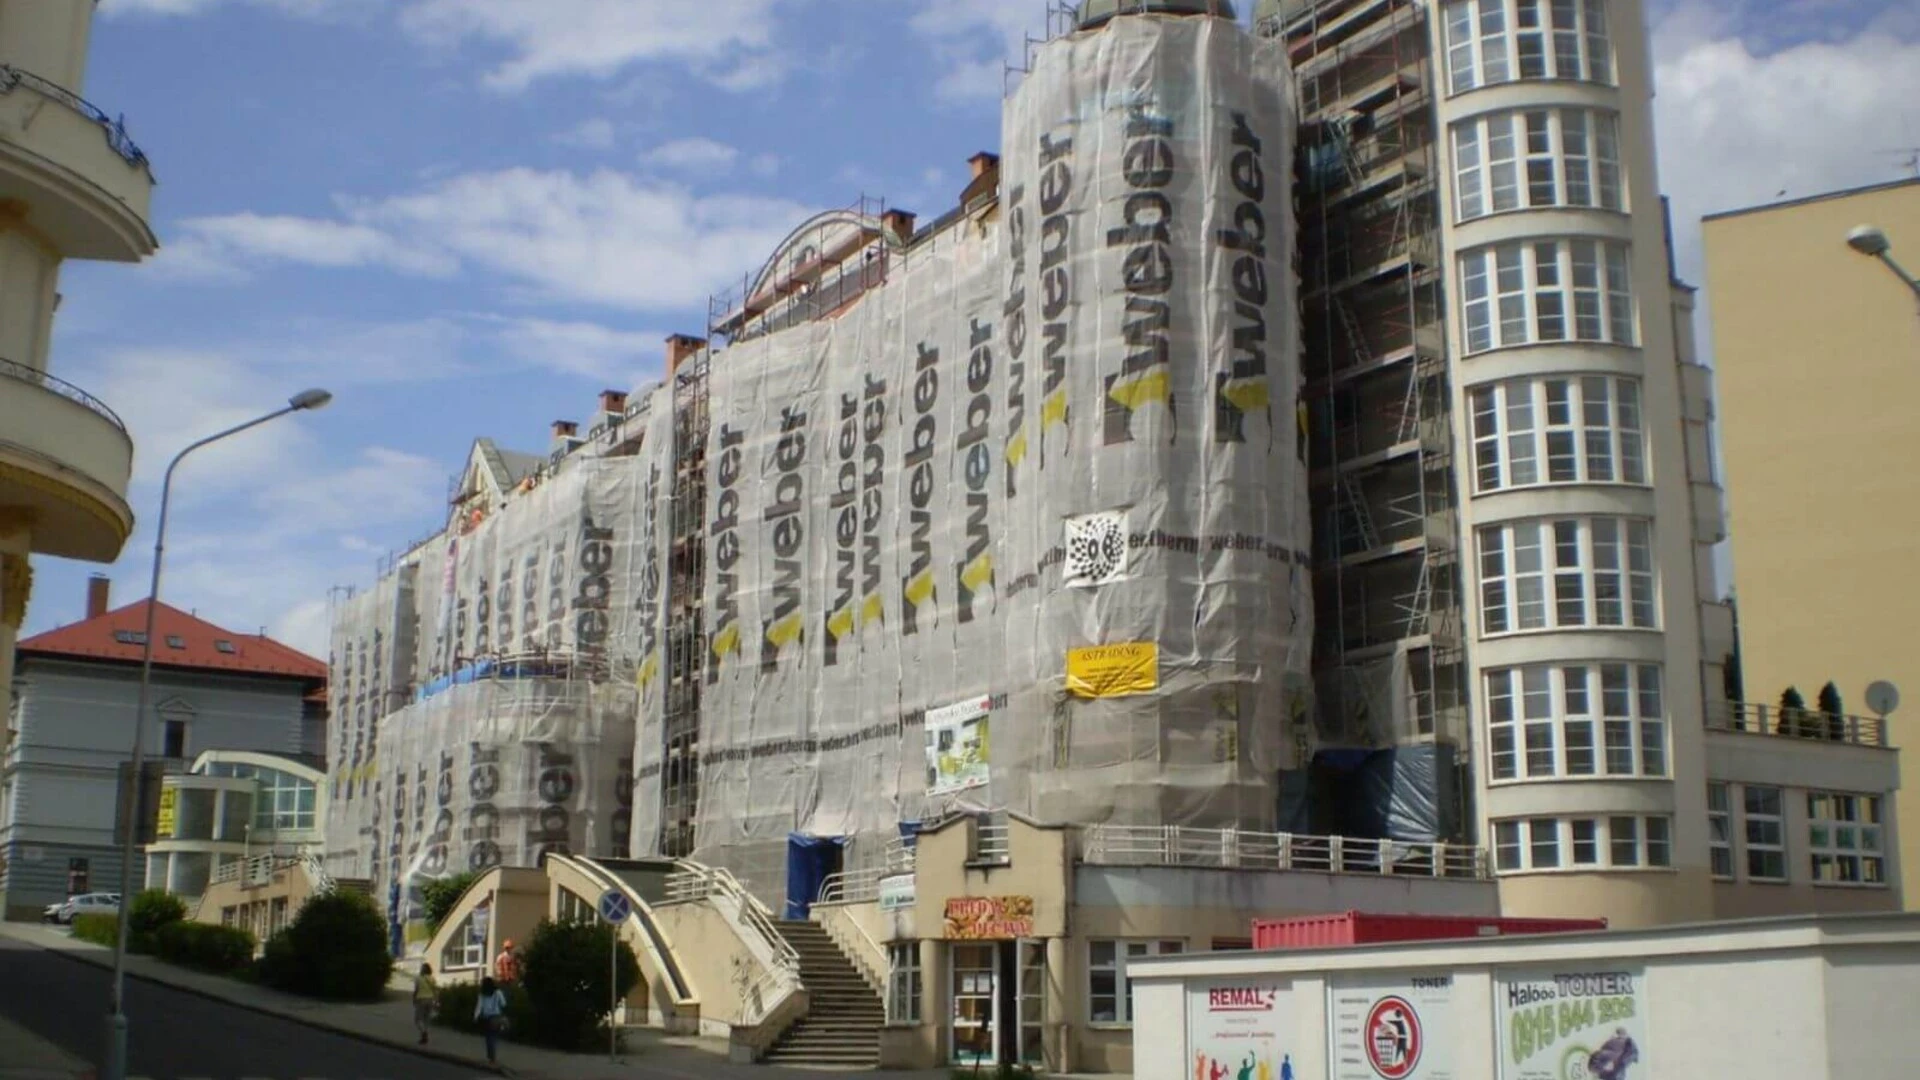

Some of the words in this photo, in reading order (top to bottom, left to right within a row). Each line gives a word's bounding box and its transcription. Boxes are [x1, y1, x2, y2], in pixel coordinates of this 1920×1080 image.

[1107, 104, 1175, 377] weber
[1217, 111, 1268, 378] weber
[710, 422, 744, 630] weber
[764, 406, 807, 621] weber
[829, 394, 858, 614] weber
[905, 341, 940, 578] weber
[957, 318, 993, 563] weber
[1209, 986, 1265, 1006] REMAL
[1411, 976, 1449, 989] TONER
[1511, 1004, 1556, 1065] 0915
[1558, 998, 1595, 1038] 844
[1553, 971, 1634, 997] TONER
